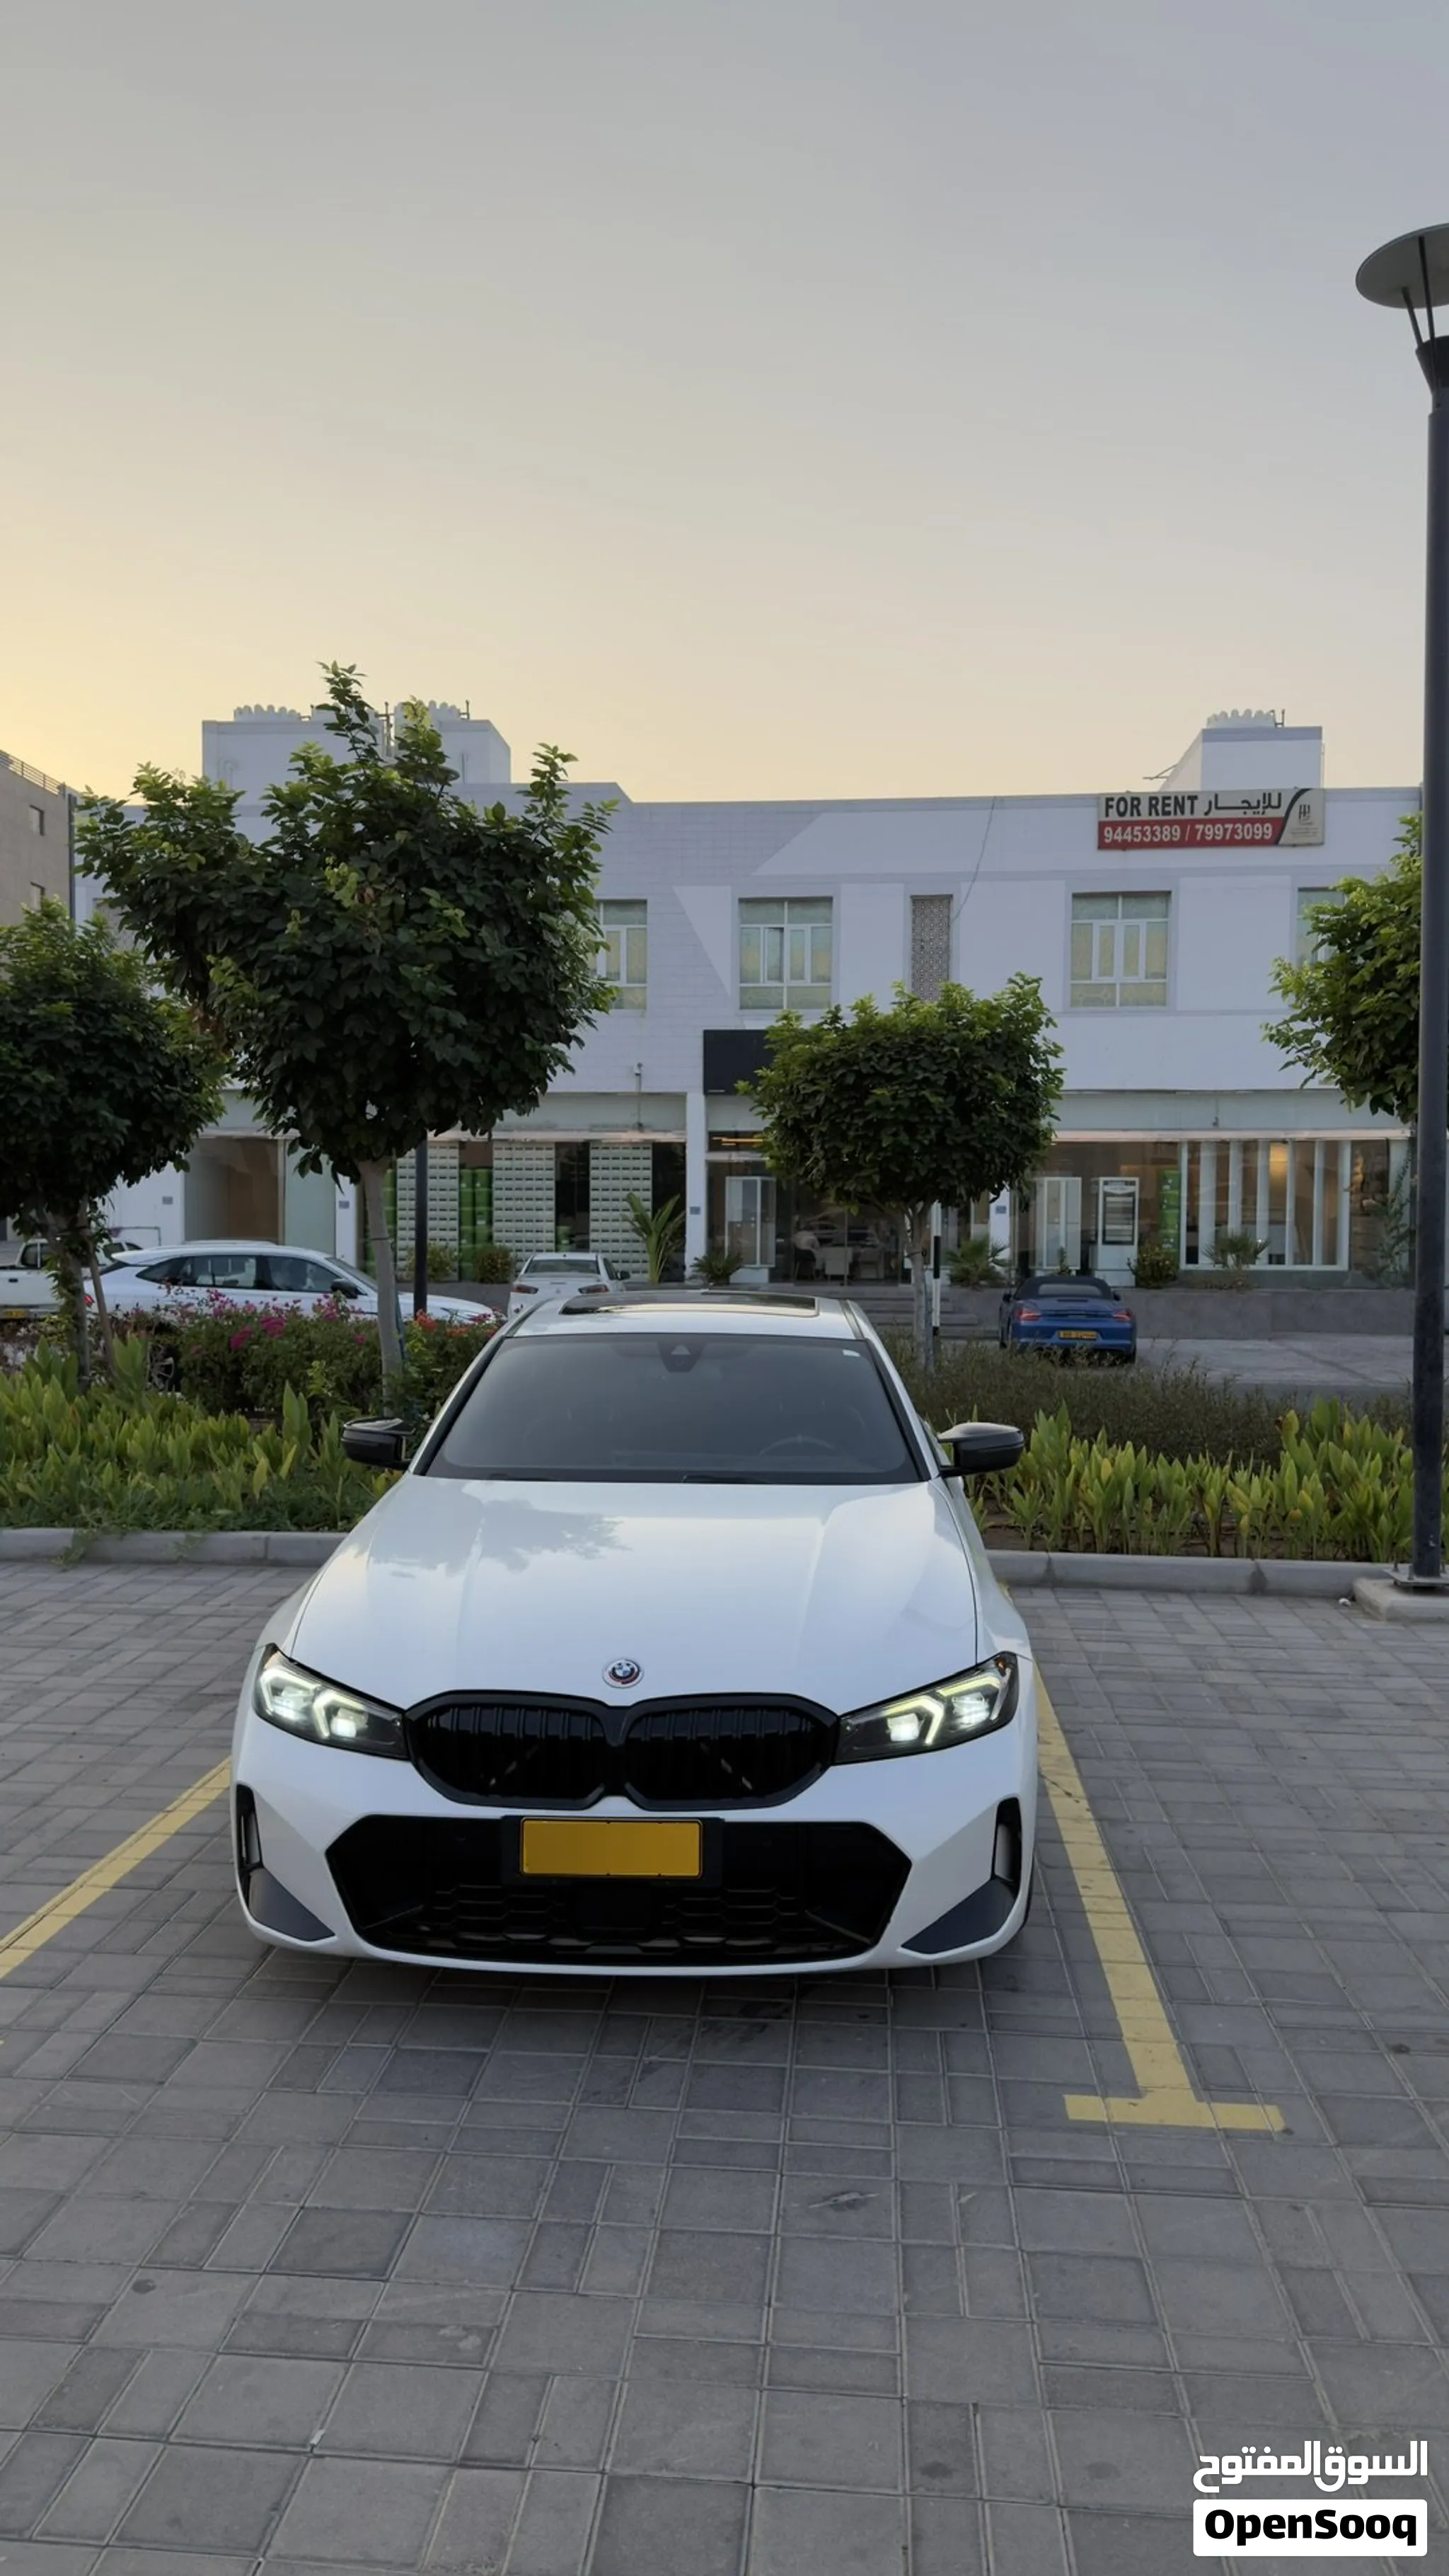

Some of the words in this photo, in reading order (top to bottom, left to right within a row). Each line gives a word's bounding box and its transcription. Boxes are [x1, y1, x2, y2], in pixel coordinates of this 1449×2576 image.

[1105, 796, 1141, 818] FOR
[1148, 795, 1199, 817] RENT
[1104, 824, 1181, 843] 94453389
[1185, 824, 1191, 842] /
[1194, 822, 1273, 841] 79973099
